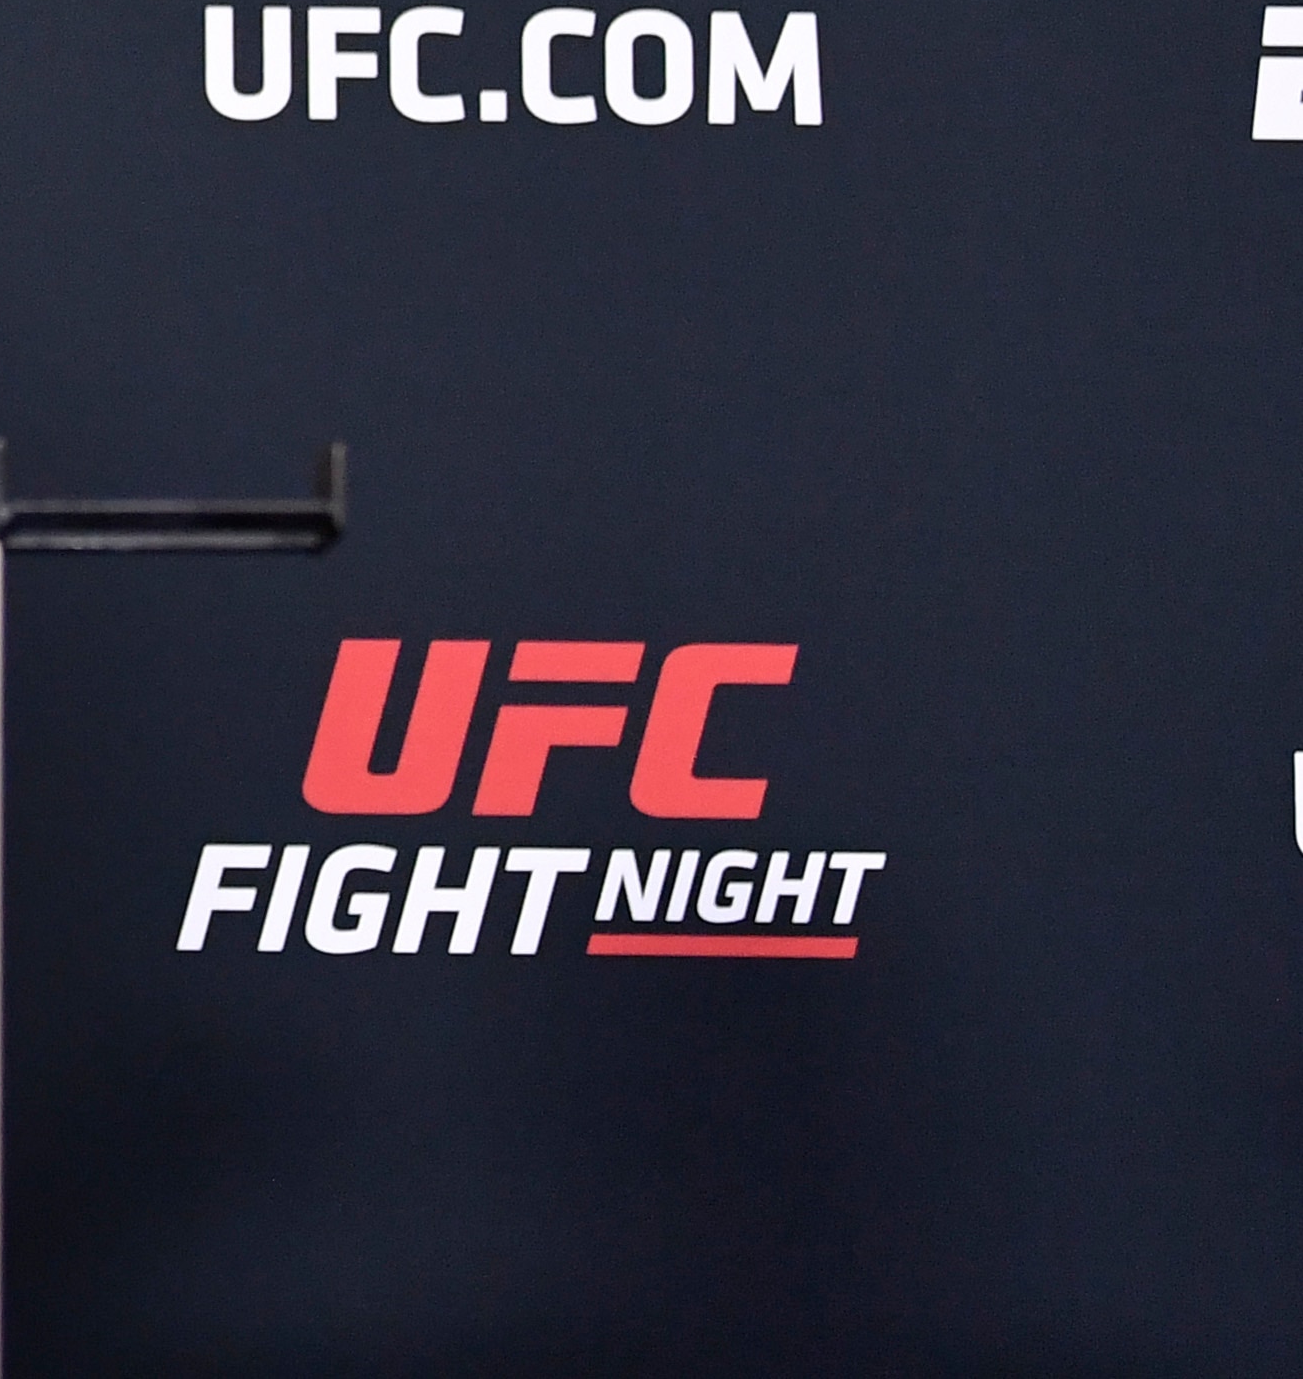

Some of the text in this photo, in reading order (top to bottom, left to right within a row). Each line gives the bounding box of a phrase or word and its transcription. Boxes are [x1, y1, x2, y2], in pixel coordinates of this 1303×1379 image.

[204, 5, 824, 126] UFC.COM
[301, 638, 799, 820] UFC
[175, 843, 888, 956] FIGHT NIGHT
